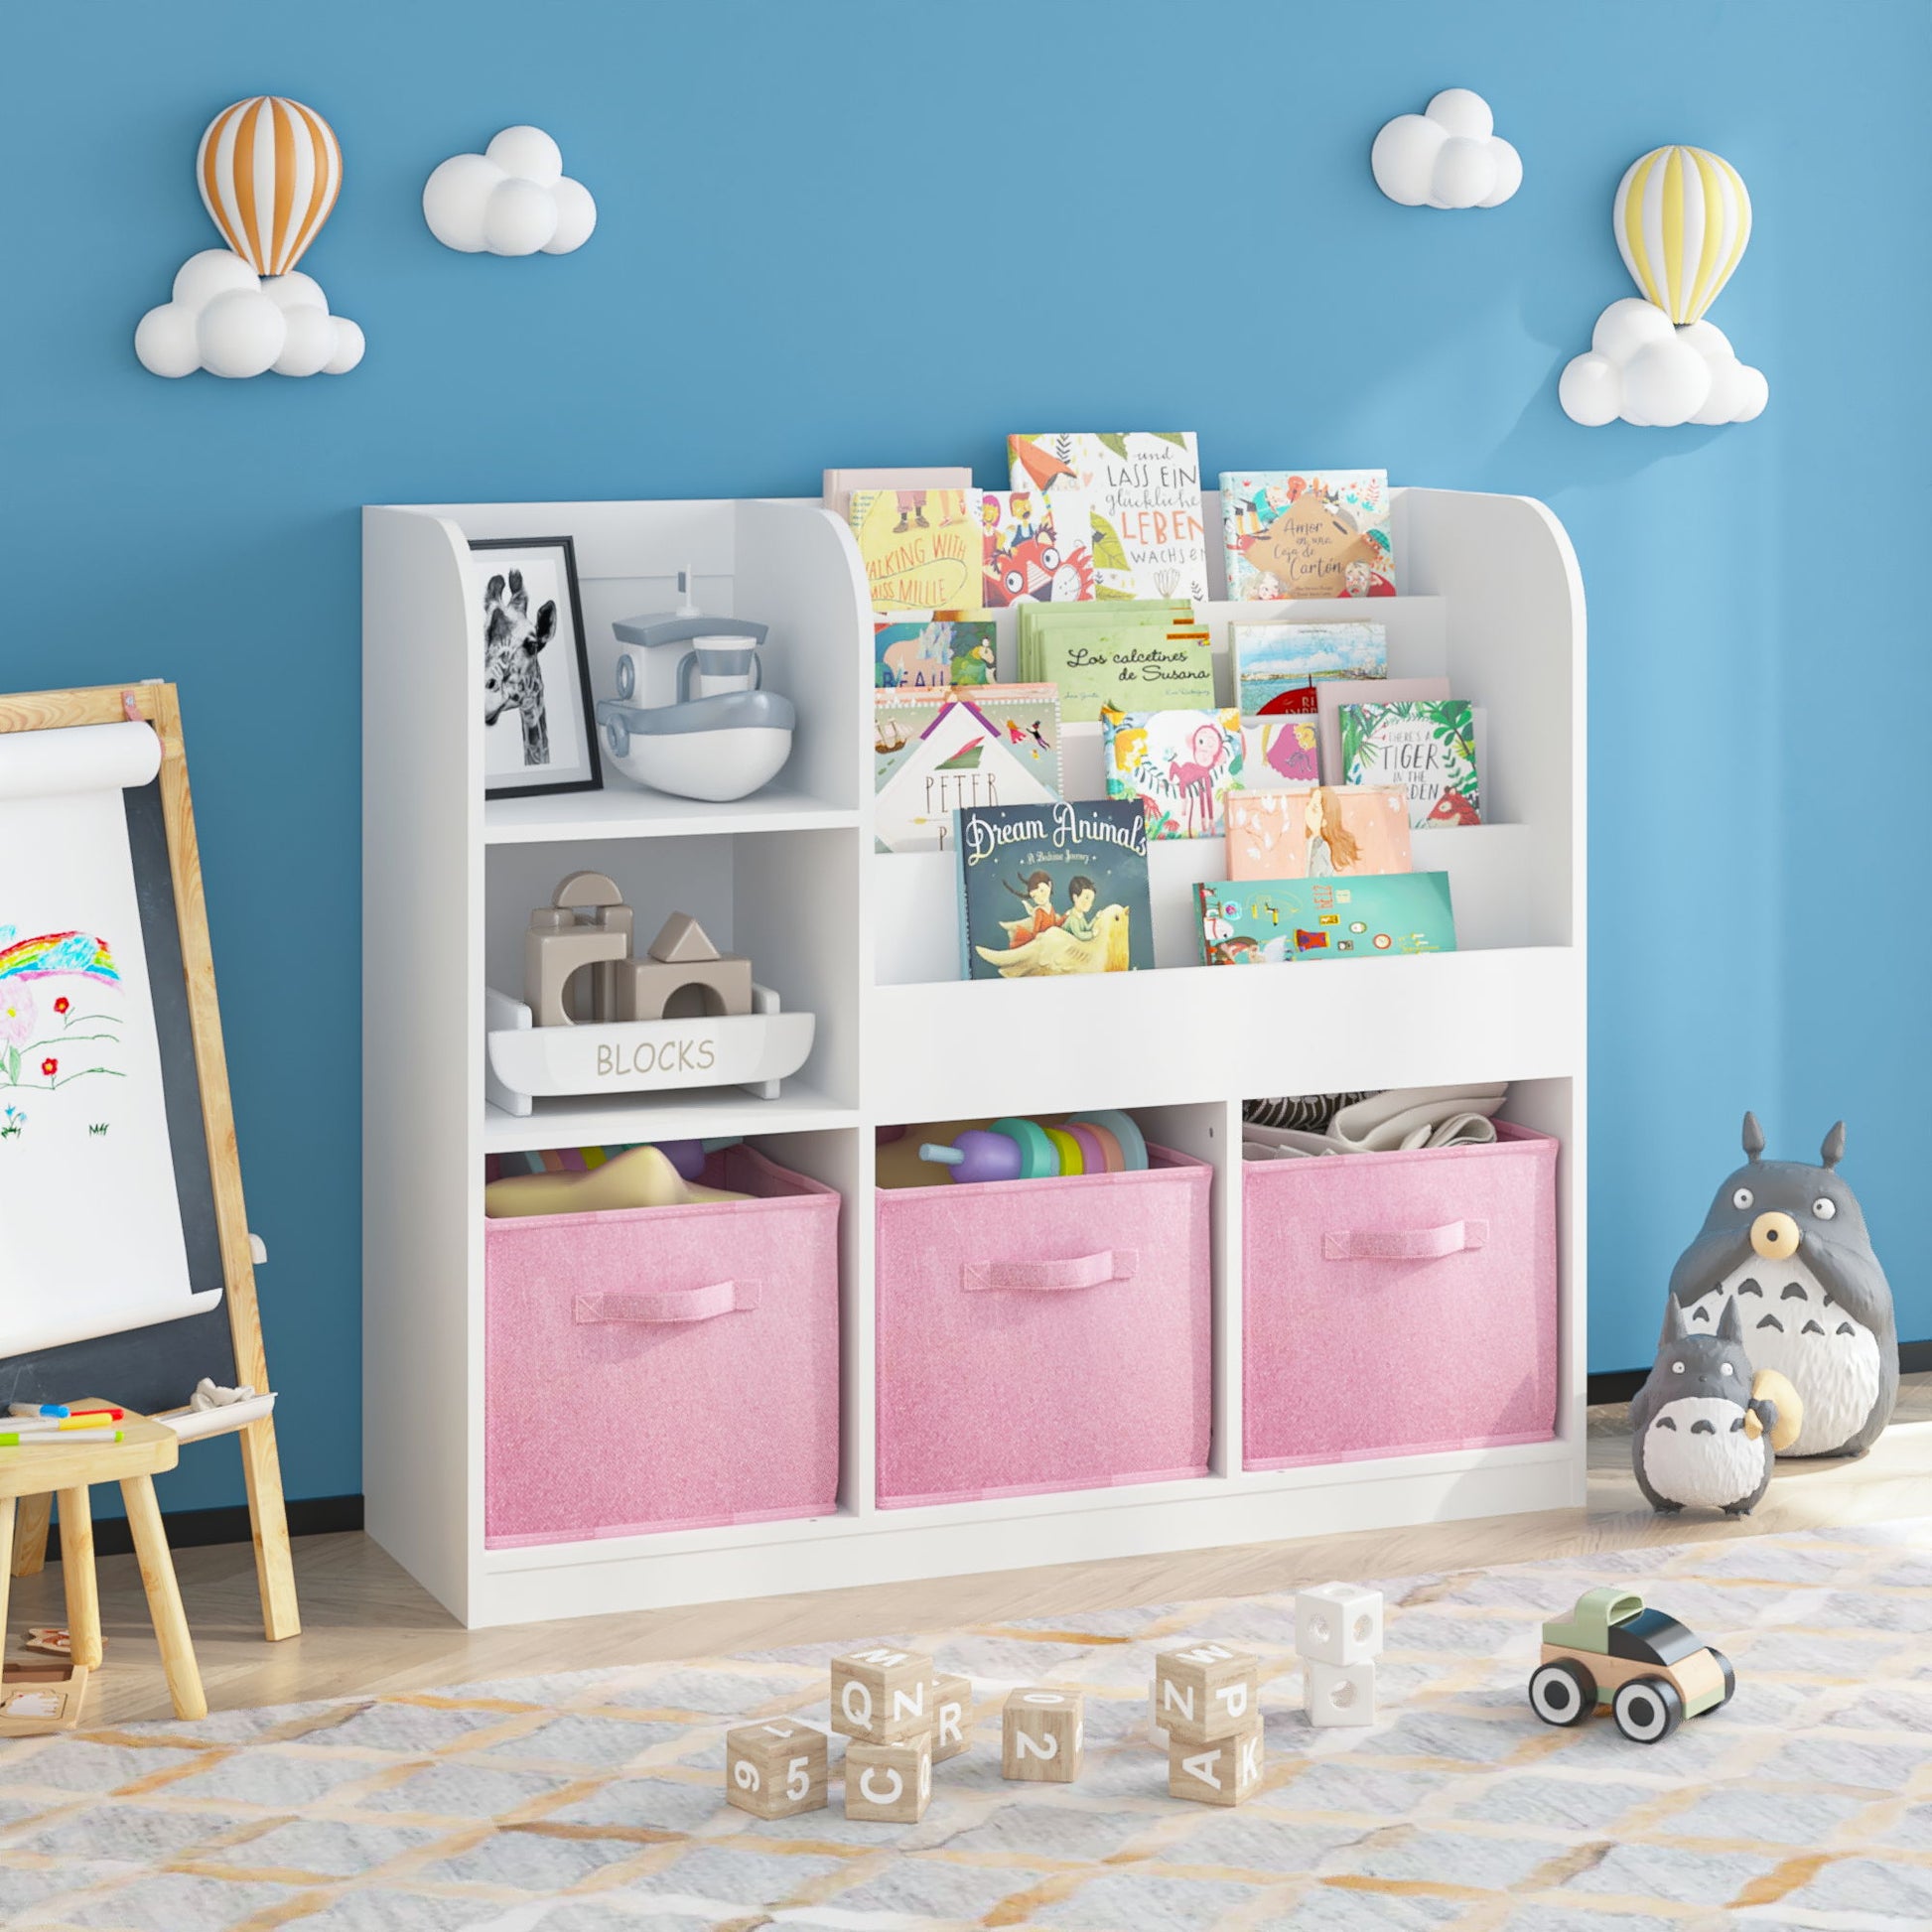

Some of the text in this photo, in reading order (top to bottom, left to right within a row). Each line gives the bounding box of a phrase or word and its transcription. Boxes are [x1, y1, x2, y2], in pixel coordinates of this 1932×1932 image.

[1136, 446, 1173, 460] und
[1161, 465, 1196, 488] EIN
[866, 533, 966, 579] ALKING WITH
[898, 579, 946, 605] MILLIE
[1067, 648, 1188, 668] Los calcetines
[1119, 665, 1210, 682] de Susana
[1379, 744, 1439, 770] TIGER
[926, 772, 999, 814] PETER
[1408, 770, 1425, 782] THE
[965, 800, 1147, 867] Dream Animals
[597, 1039, 715, 1076] BLOCKS
[842, 1681, 873, 1731] Q
[1216, 1682, 1247, 1718] P
[939, 1703, 963, 1746] R
[1017, 1730, 1057, 1760] 2
[1242, 1736, 1258, 1787] K
[786, 1756, 809, 1801] 5
[1182, 1749, 1221, 1791] A
